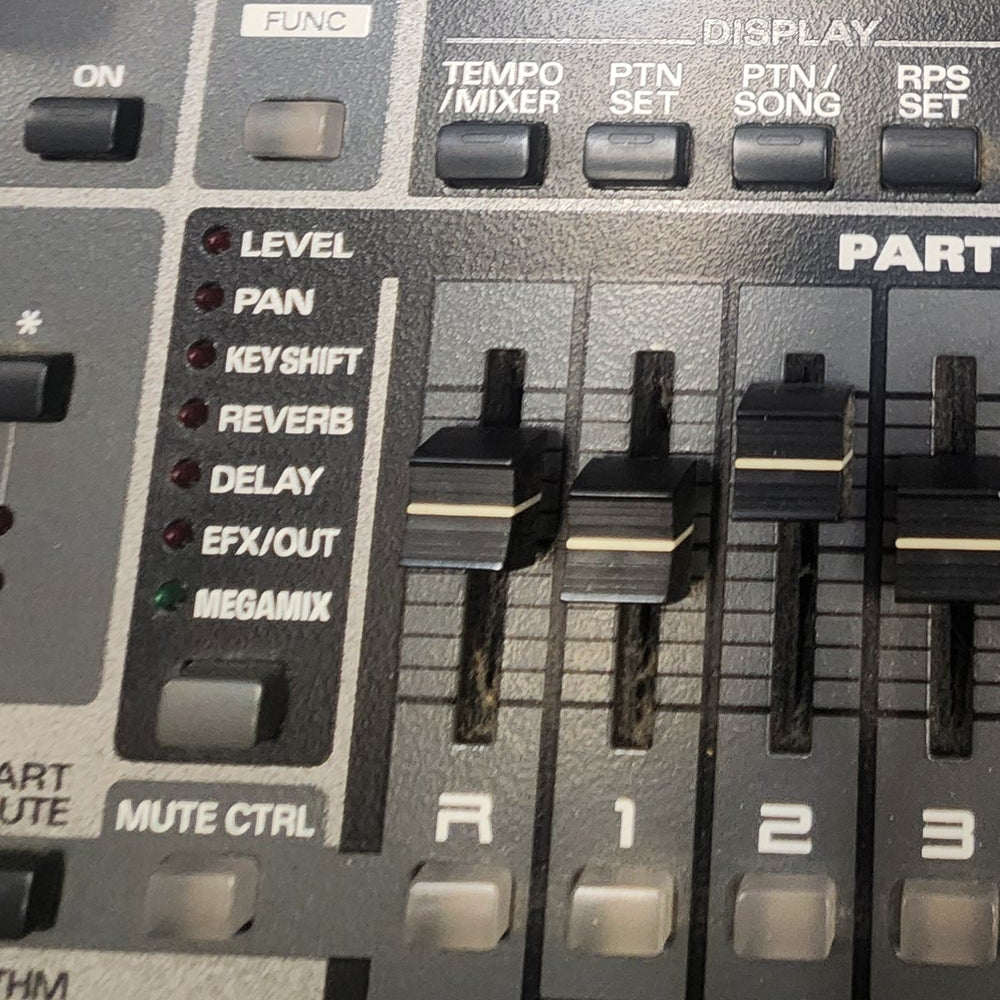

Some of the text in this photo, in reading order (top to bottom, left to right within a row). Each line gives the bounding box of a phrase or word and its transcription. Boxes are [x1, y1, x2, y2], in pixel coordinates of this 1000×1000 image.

[264, 10, 347, 33] FUNC
[702, 18, 880, 47] DISPLAY
[72, 64, 125, 88] ON
[442, 60, 564, 87] TEMPO
[610, 62, 683, 87] PTN
[898, 65, 970, 90] RPS
[438, 88, 560, 115] /MIXER
[609, 90, 678, 115] SET
[733, 90, 841, 118] SONG
[899, 93, 967, 119] SET
[240, 231, 354, 258] LEVEL
[233, 288, 315, 316] PAN
[224, 345, 363, 376] KEYSHIFT
[218, 404, 355, 435] REVERB
[209, 465, 325, 495] DELAY
[201, 527, 341, 558] EFX/OUT
[193, 588, 333, 622] MEGAMIX
[115, 799, 315, 838] MUTE CTRL
[435, 792, 493, 844] R
[614, 798, 636, 849] 1
[758, 802, 813, 855] 2
[921, 808, 975, 861] 3
